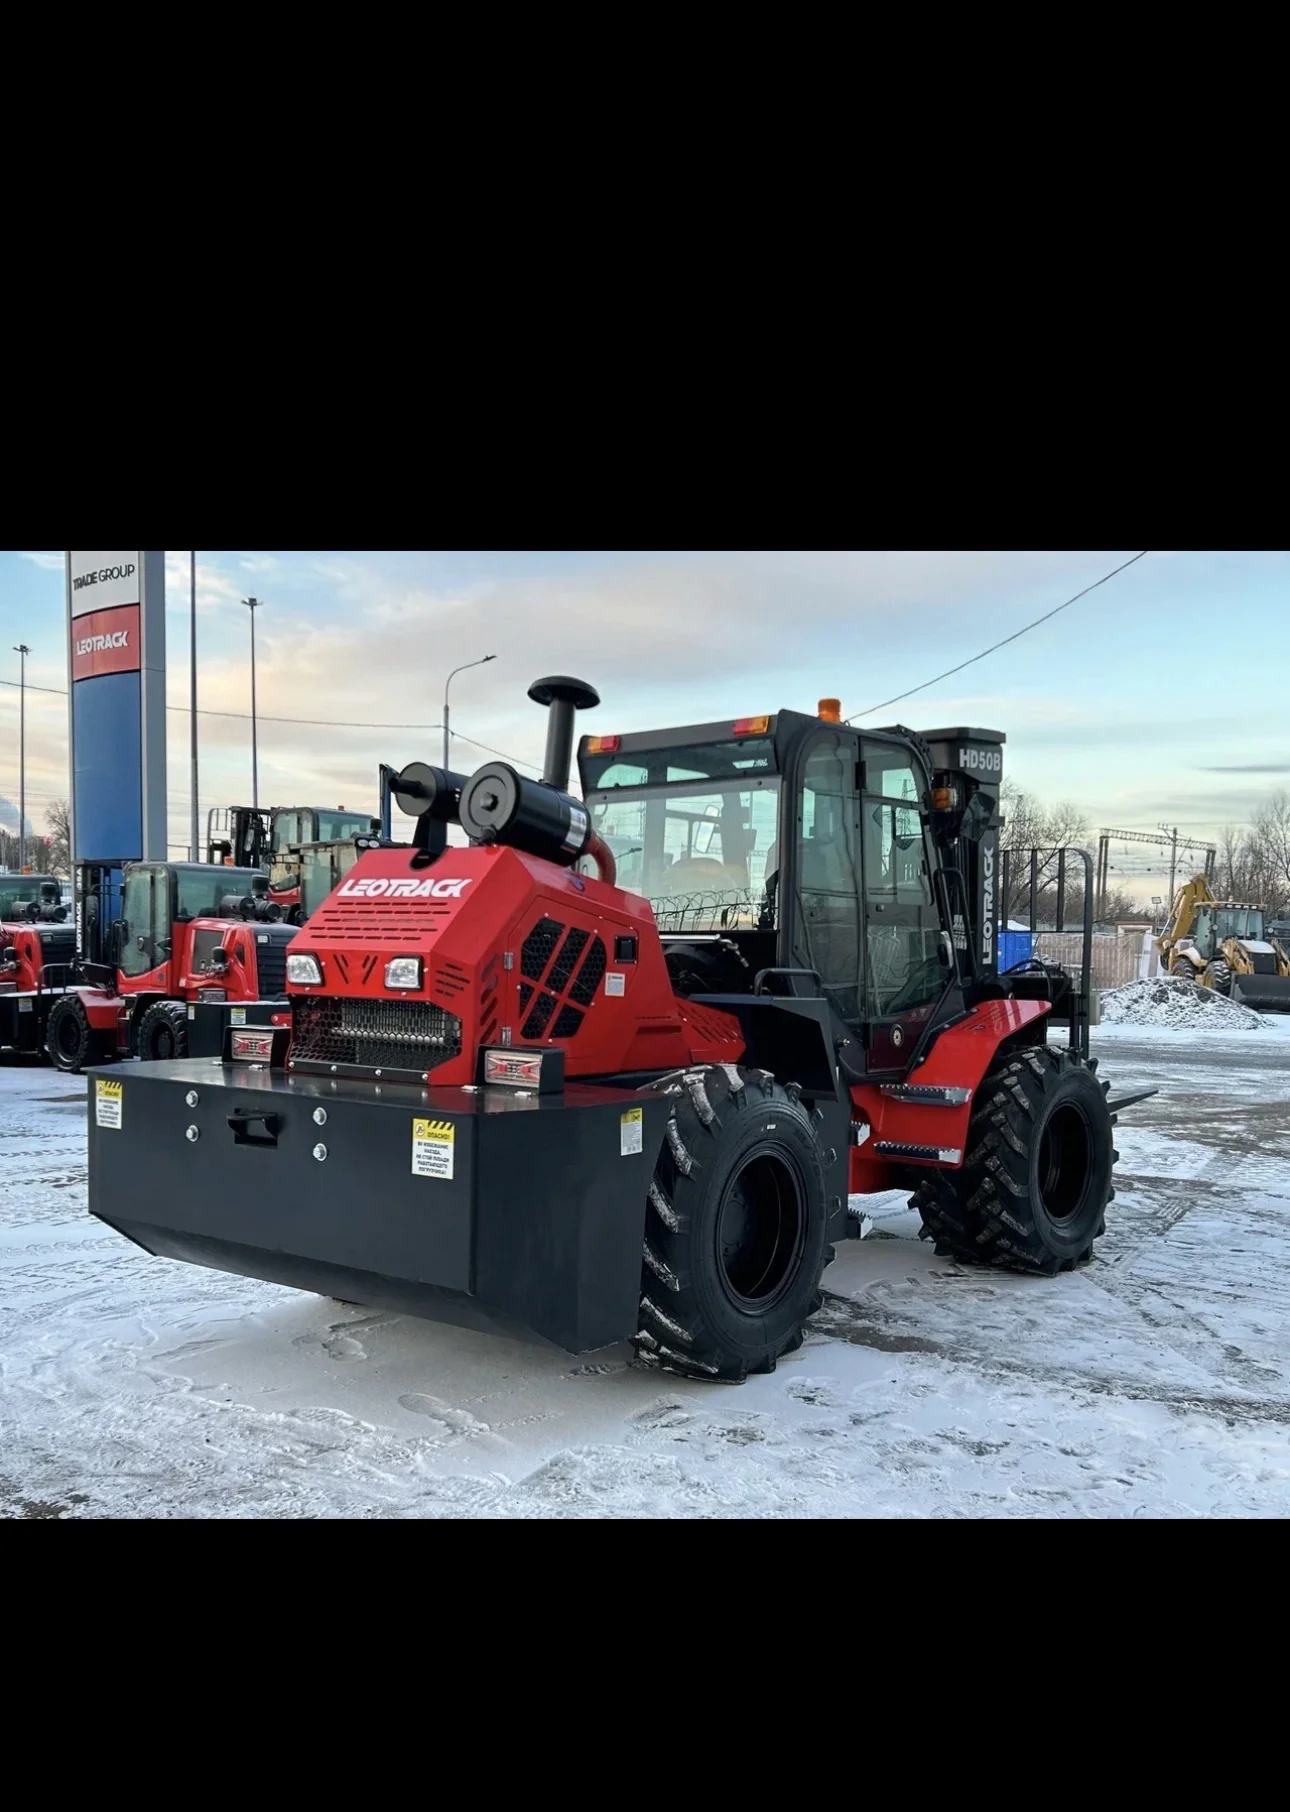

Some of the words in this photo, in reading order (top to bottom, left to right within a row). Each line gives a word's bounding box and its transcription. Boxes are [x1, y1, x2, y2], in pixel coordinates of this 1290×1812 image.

[73, 571, 98, 591] TRADE
[98, 564, 135, 582] GROUP
[77, 631, 128, 656] LEOTRACK
[959, 748, 1001, 771] HD50B
[336, 878, 473, 898] LEOTRACK
[982, 846, 994, 965] LEOTRACK
